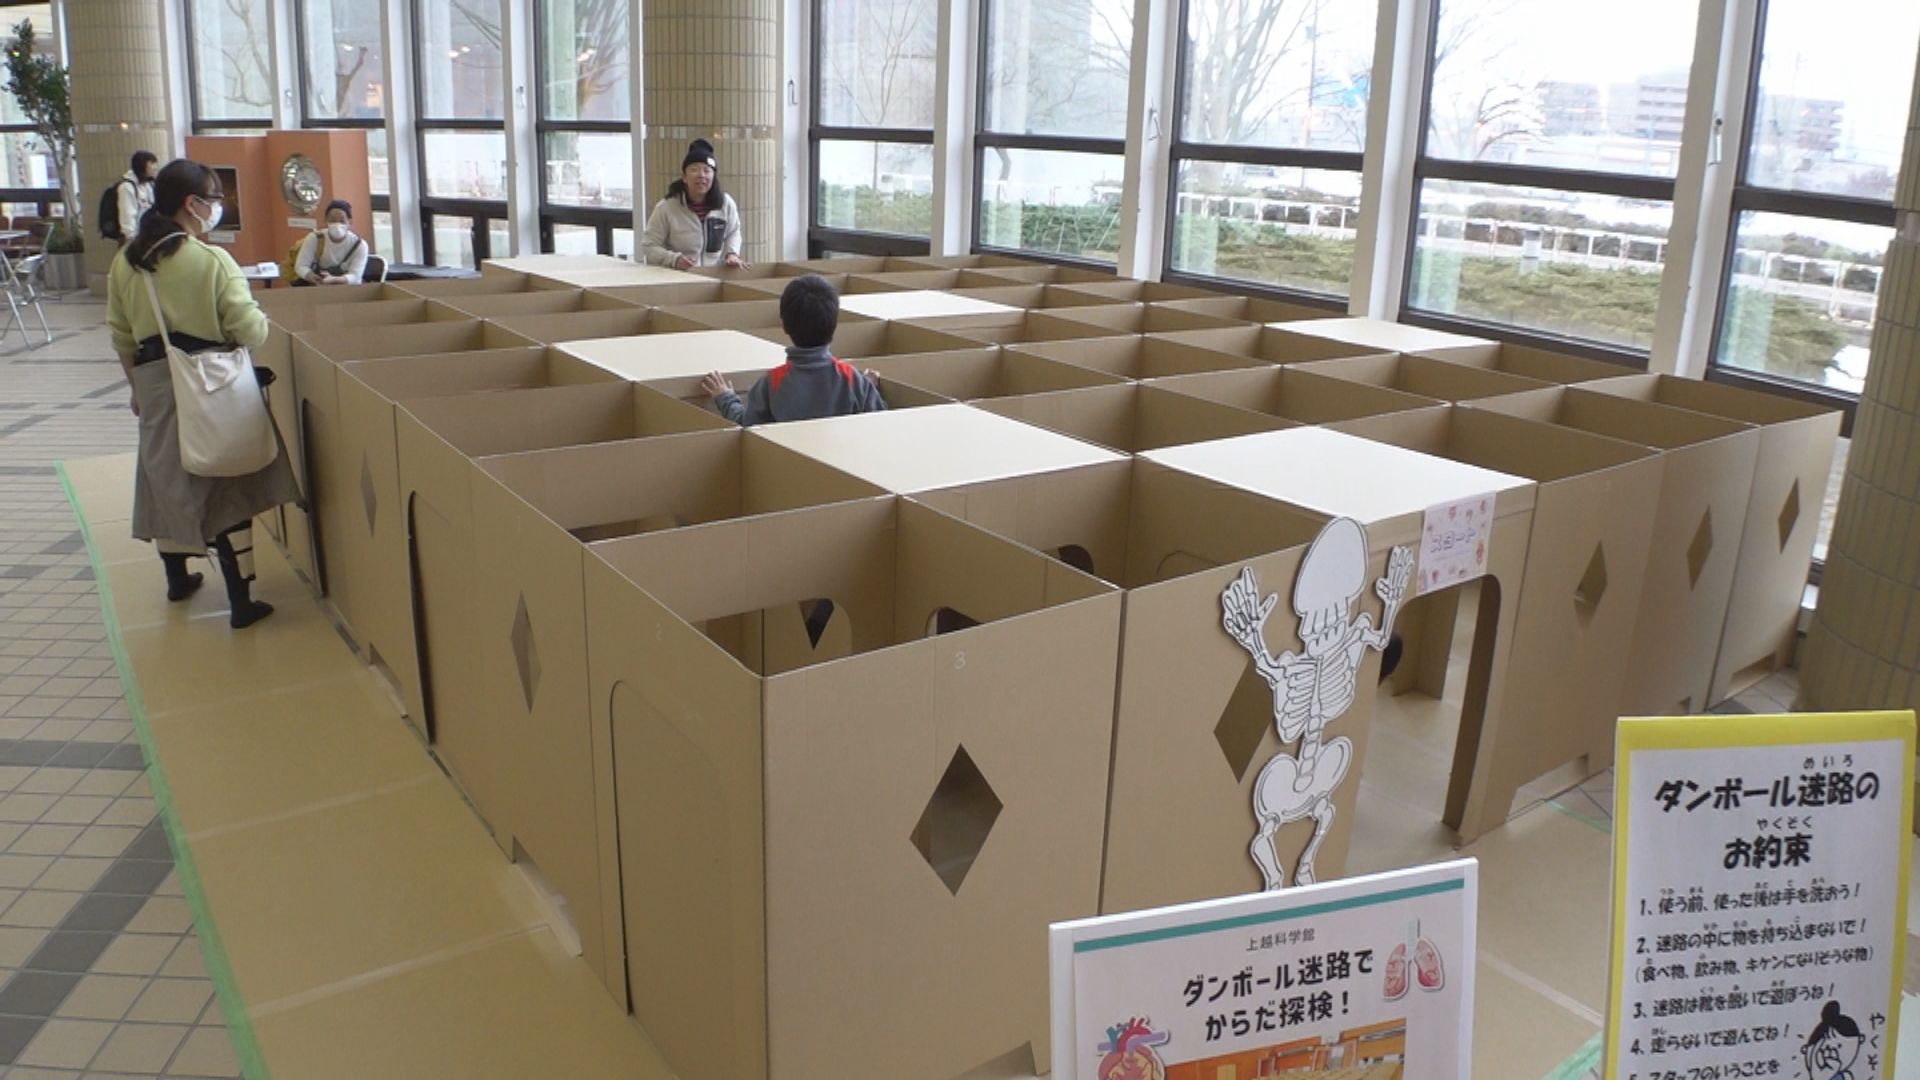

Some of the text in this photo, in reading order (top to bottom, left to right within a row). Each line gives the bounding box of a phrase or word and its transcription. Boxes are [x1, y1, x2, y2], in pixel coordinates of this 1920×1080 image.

[953, 650, 966, 670] 3
[1654, 772, 1880, 812] ダンボール迷路の
[1757, 816, 1813, 831] やくそく
[1723, 833, 1813, 869] お約束
[1246, 927, 1316, 952] 上越科学館
[1183, 949, 1374, 1007] ダンボール迷路で
